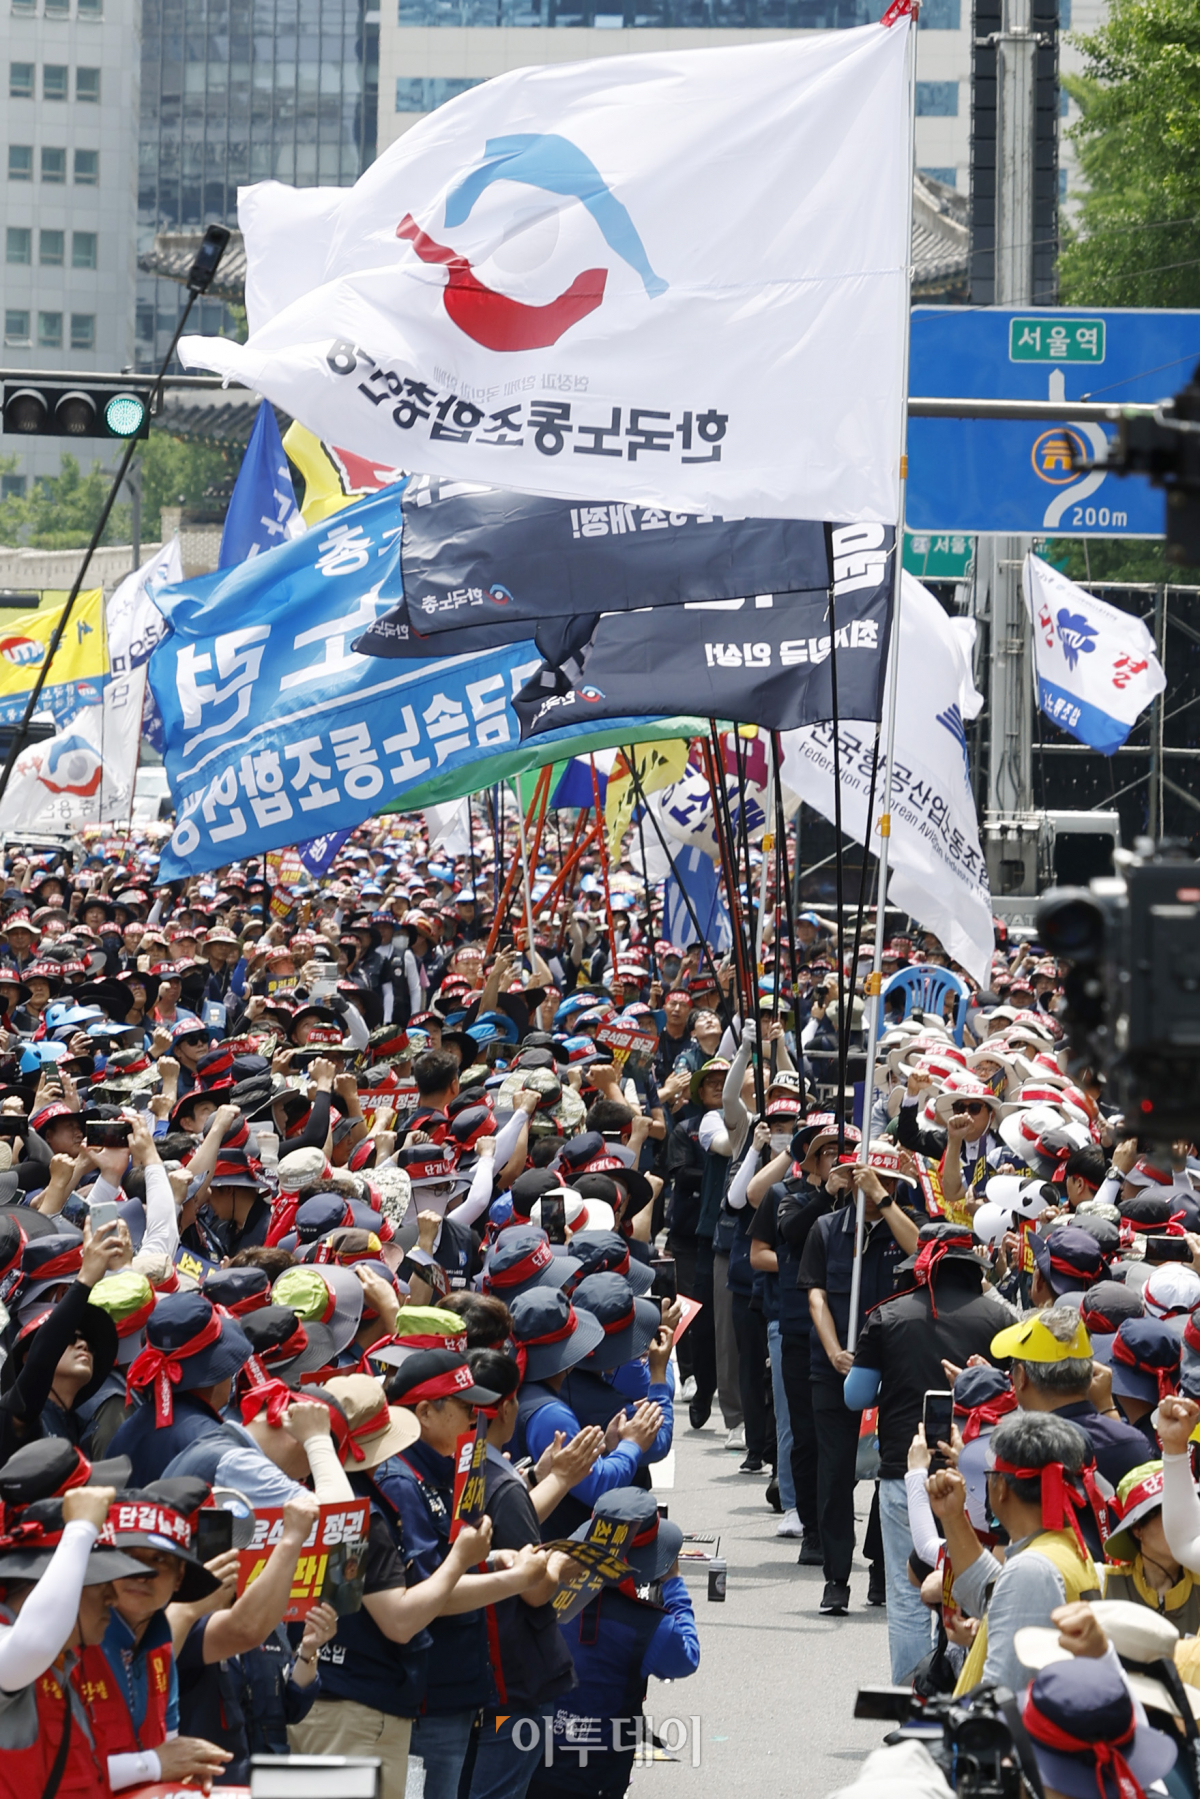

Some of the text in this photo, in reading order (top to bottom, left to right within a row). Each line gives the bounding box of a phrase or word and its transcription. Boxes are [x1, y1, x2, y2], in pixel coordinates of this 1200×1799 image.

[1017, 326, 1098, 357] 서울역
[1072, 507, 1128, 528] 200m
[358, 1092, 421, 1111] 윤석열 정권
[118, 1506, 157, 1531] 단결
[322, 1509, 366, 1546] 정권
